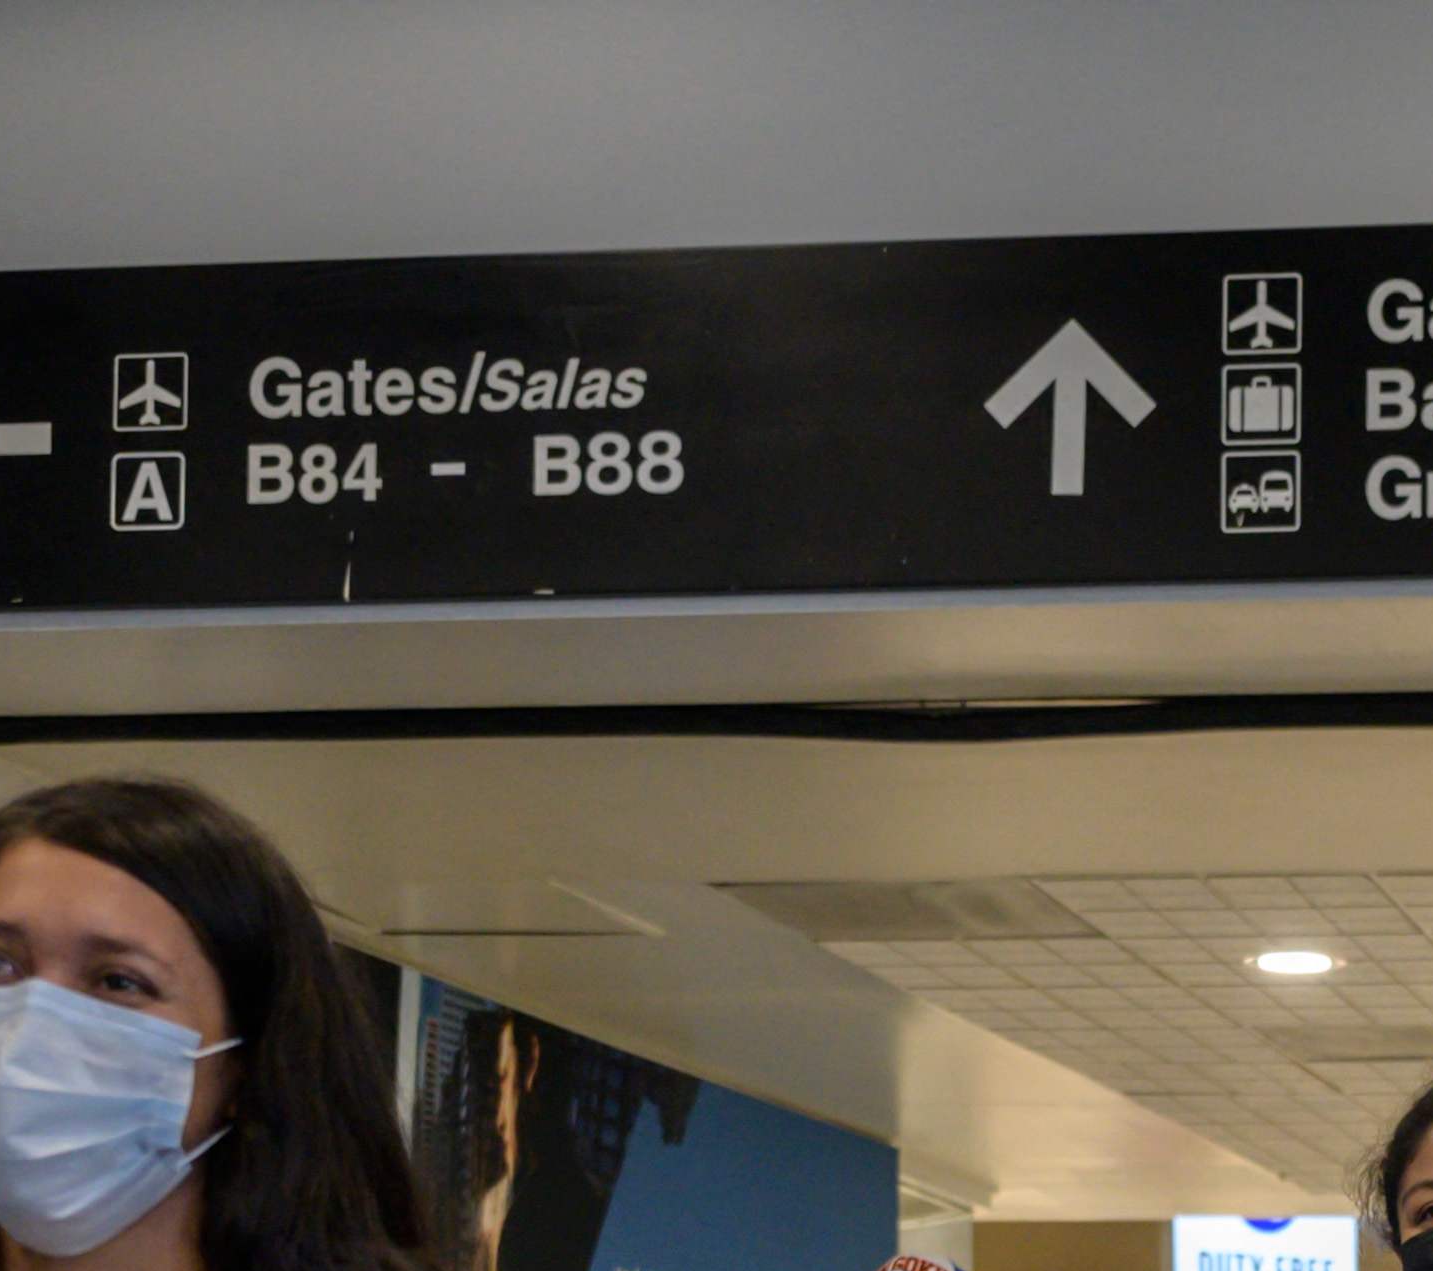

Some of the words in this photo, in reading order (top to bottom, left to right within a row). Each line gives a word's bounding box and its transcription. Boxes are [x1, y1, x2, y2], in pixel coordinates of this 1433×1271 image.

[247, 351, 649, 421] Gates/Salas
[121, 461, 174, 523] A
[246, 443, 384, 507] B84
[531, 430, 685, 498] B88
